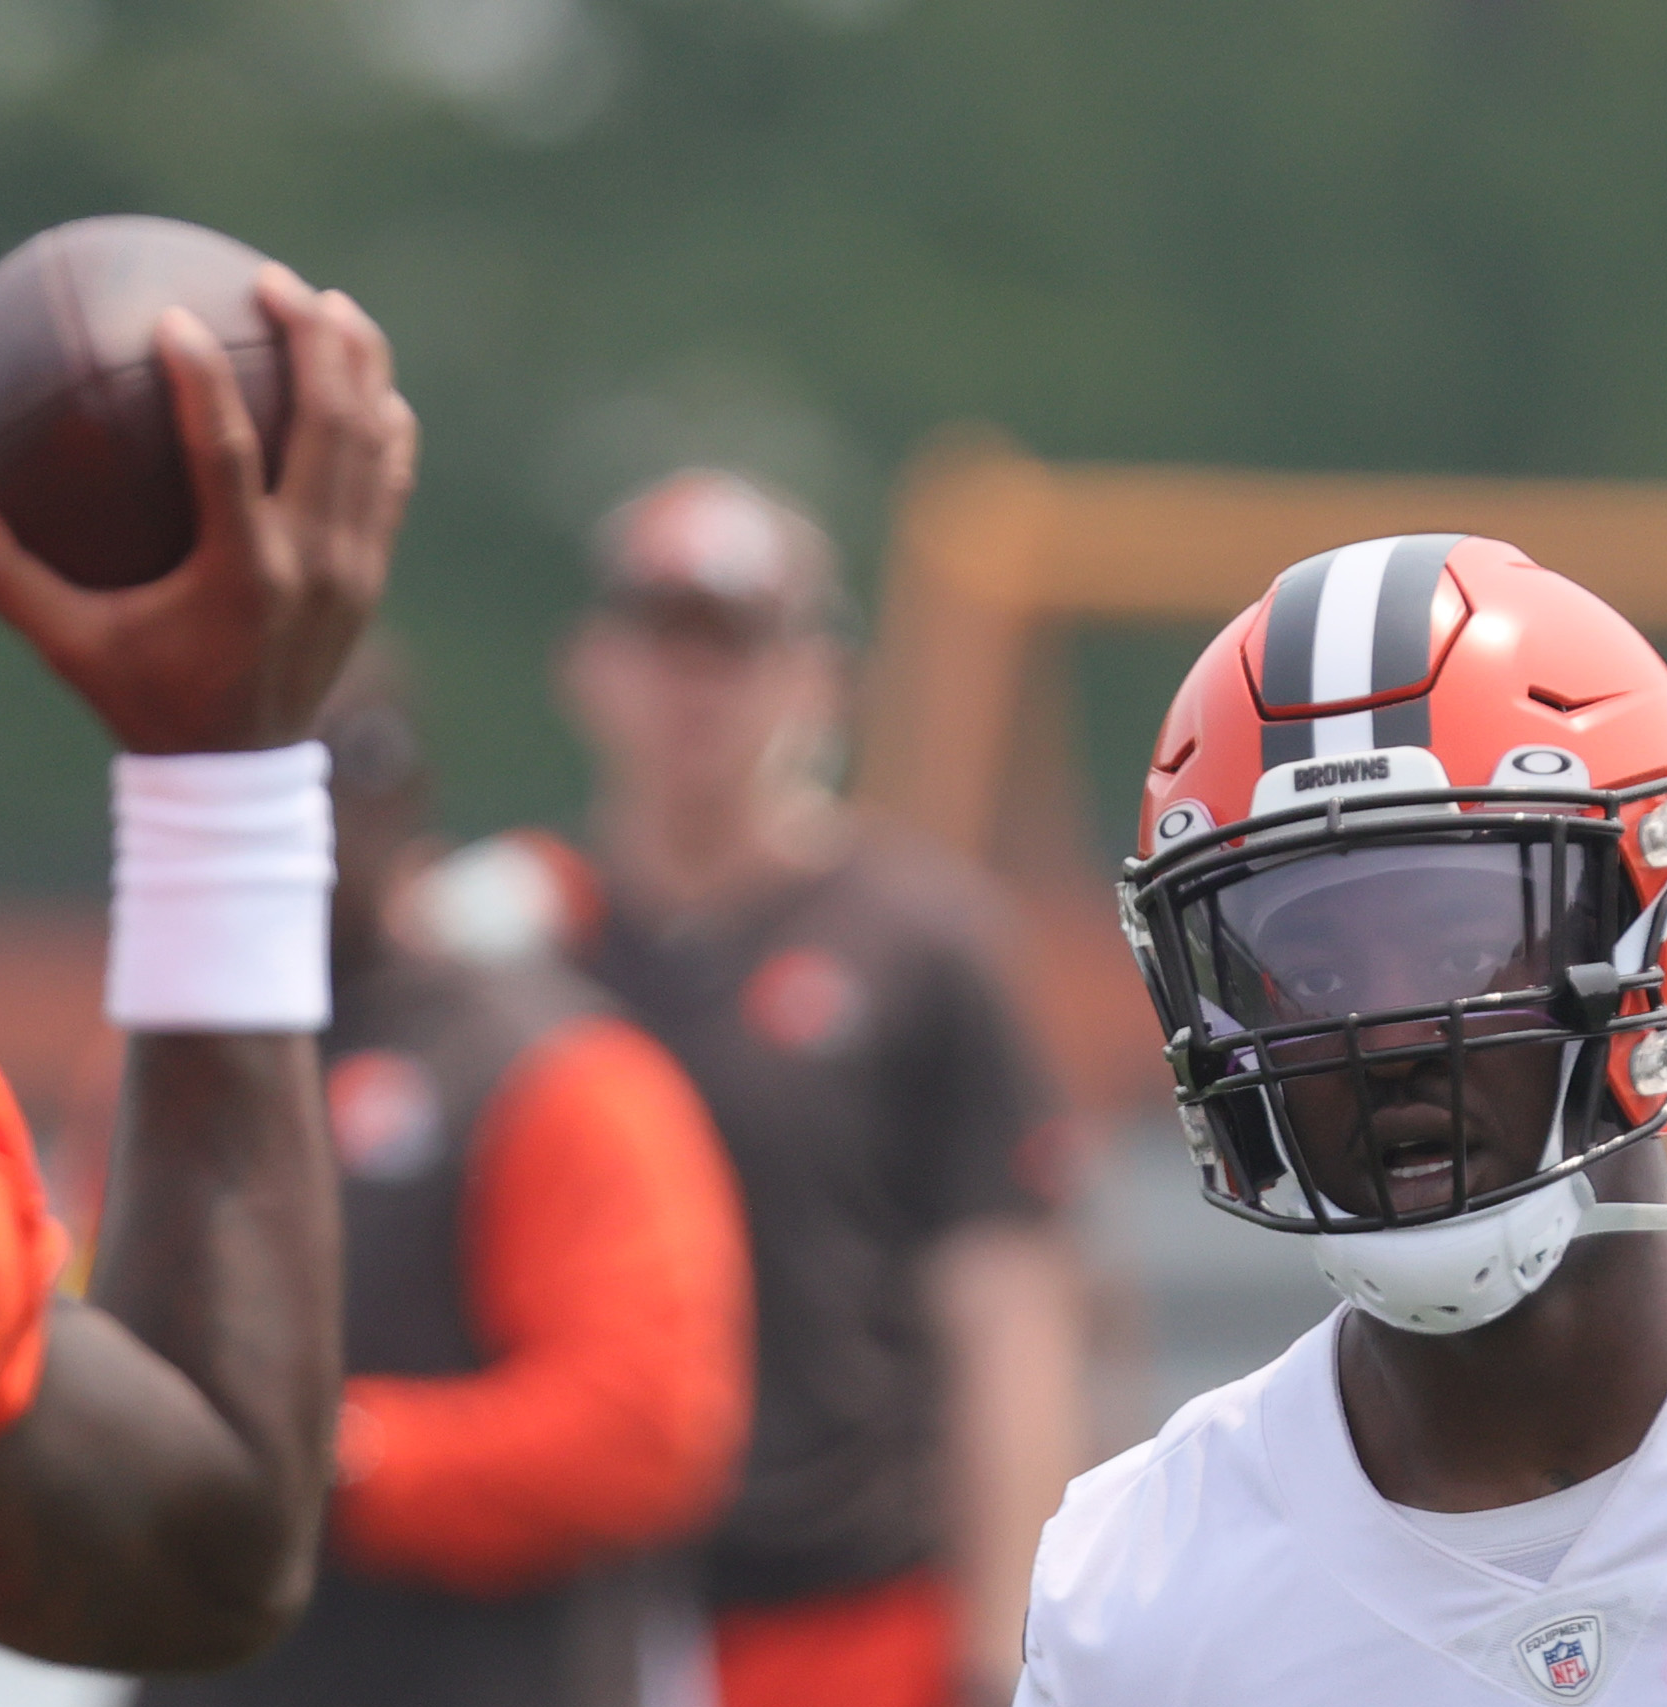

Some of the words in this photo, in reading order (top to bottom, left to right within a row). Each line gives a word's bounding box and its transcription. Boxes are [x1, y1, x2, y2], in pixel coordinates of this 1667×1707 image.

[1294, 756, 1390, 792] BROWNS
[1525, 1620, 1595, 1654] EQUIPMENT
[1549, 1656, 1588, 1685] NFL
